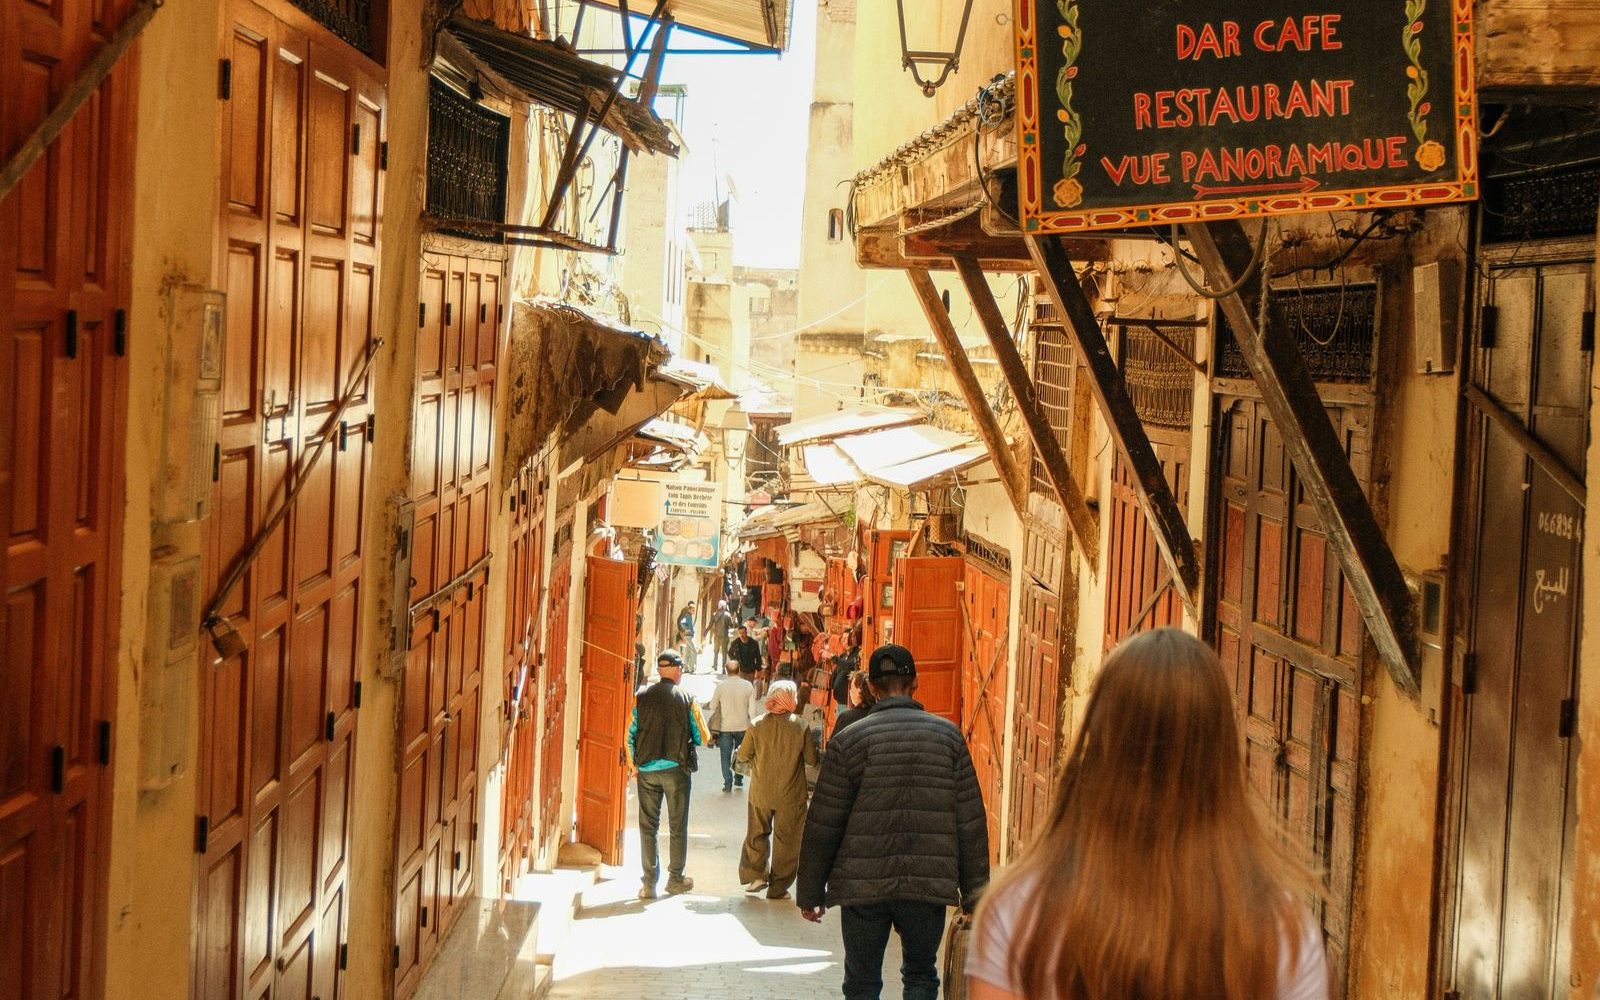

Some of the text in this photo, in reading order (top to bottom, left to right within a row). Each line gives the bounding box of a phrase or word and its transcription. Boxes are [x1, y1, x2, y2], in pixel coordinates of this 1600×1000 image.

[1176, 14, 1343, 61] DAR CAFE
[1133, 79, 1354, 131] RESTAURANT
[1101, 136, 1408, 186] VUE PANORAMIQUE
[1533, 567, 1569, 614] للبيع
